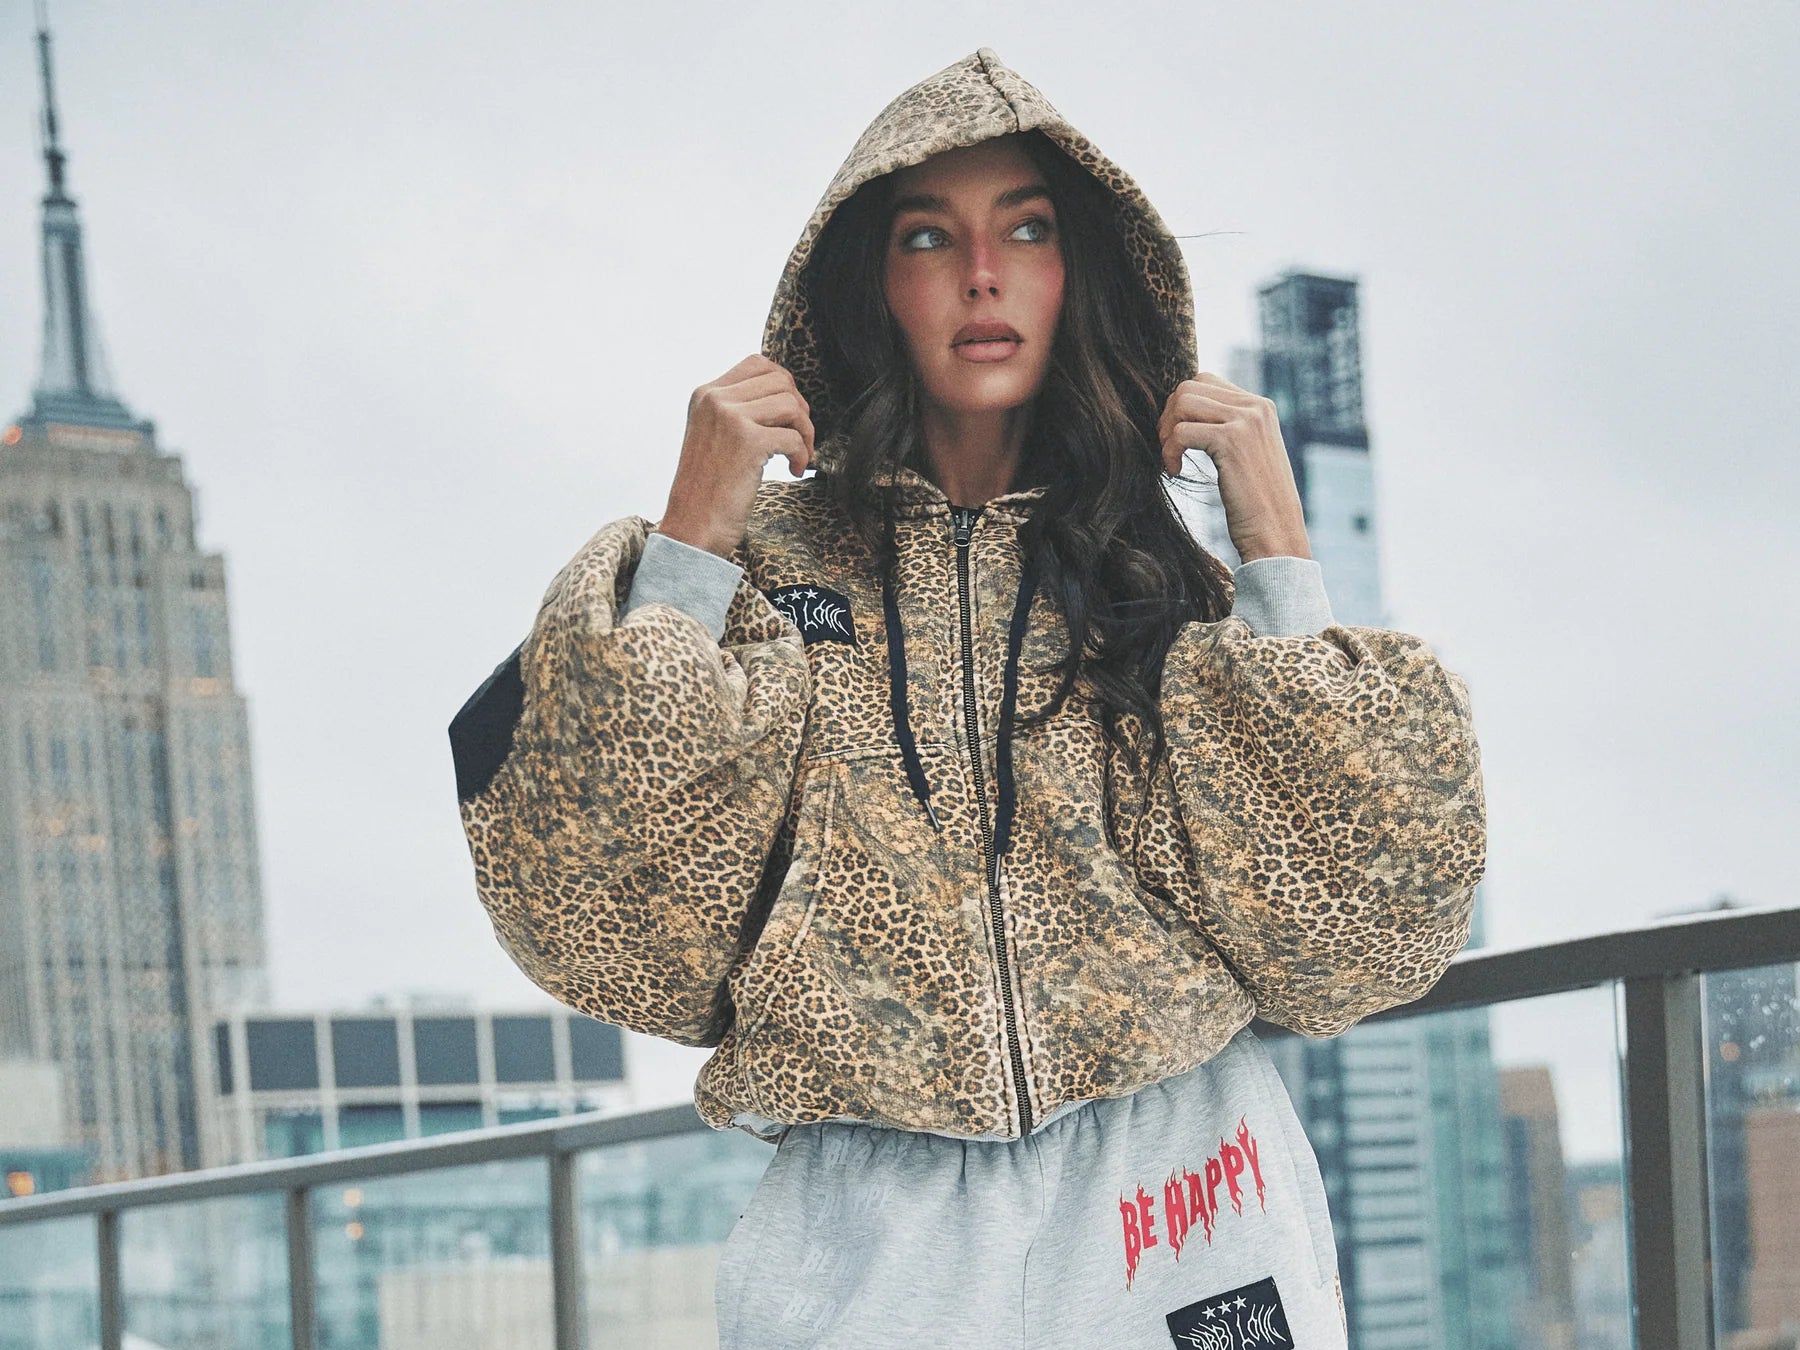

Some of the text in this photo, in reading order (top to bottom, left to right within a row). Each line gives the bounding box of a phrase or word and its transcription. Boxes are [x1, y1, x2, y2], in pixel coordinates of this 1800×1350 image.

[1120, 1113, 1267, 1292] BE HAPPY
[779, 1290, 818, 1326] BE
